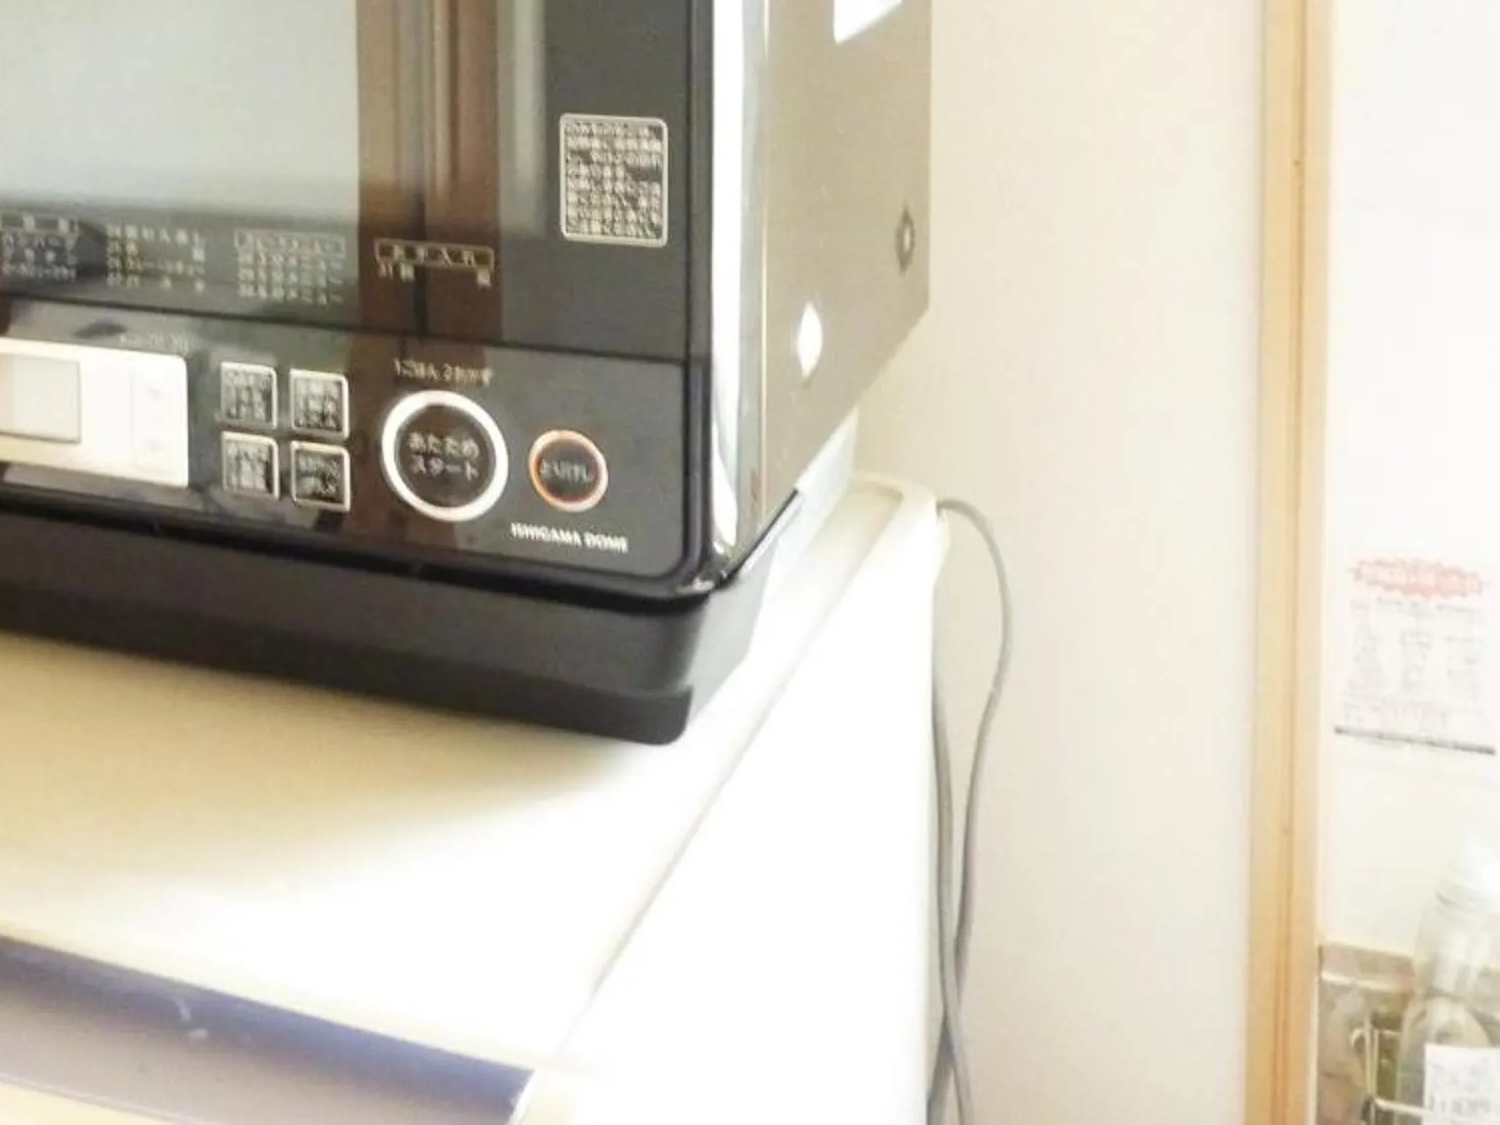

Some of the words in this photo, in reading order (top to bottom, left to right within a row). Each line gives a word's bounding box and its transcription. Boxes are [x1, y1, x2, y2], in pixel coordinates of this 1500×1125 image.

[407, 431, 481, 459] あたため
[409, 453, 480, 483] スタート
